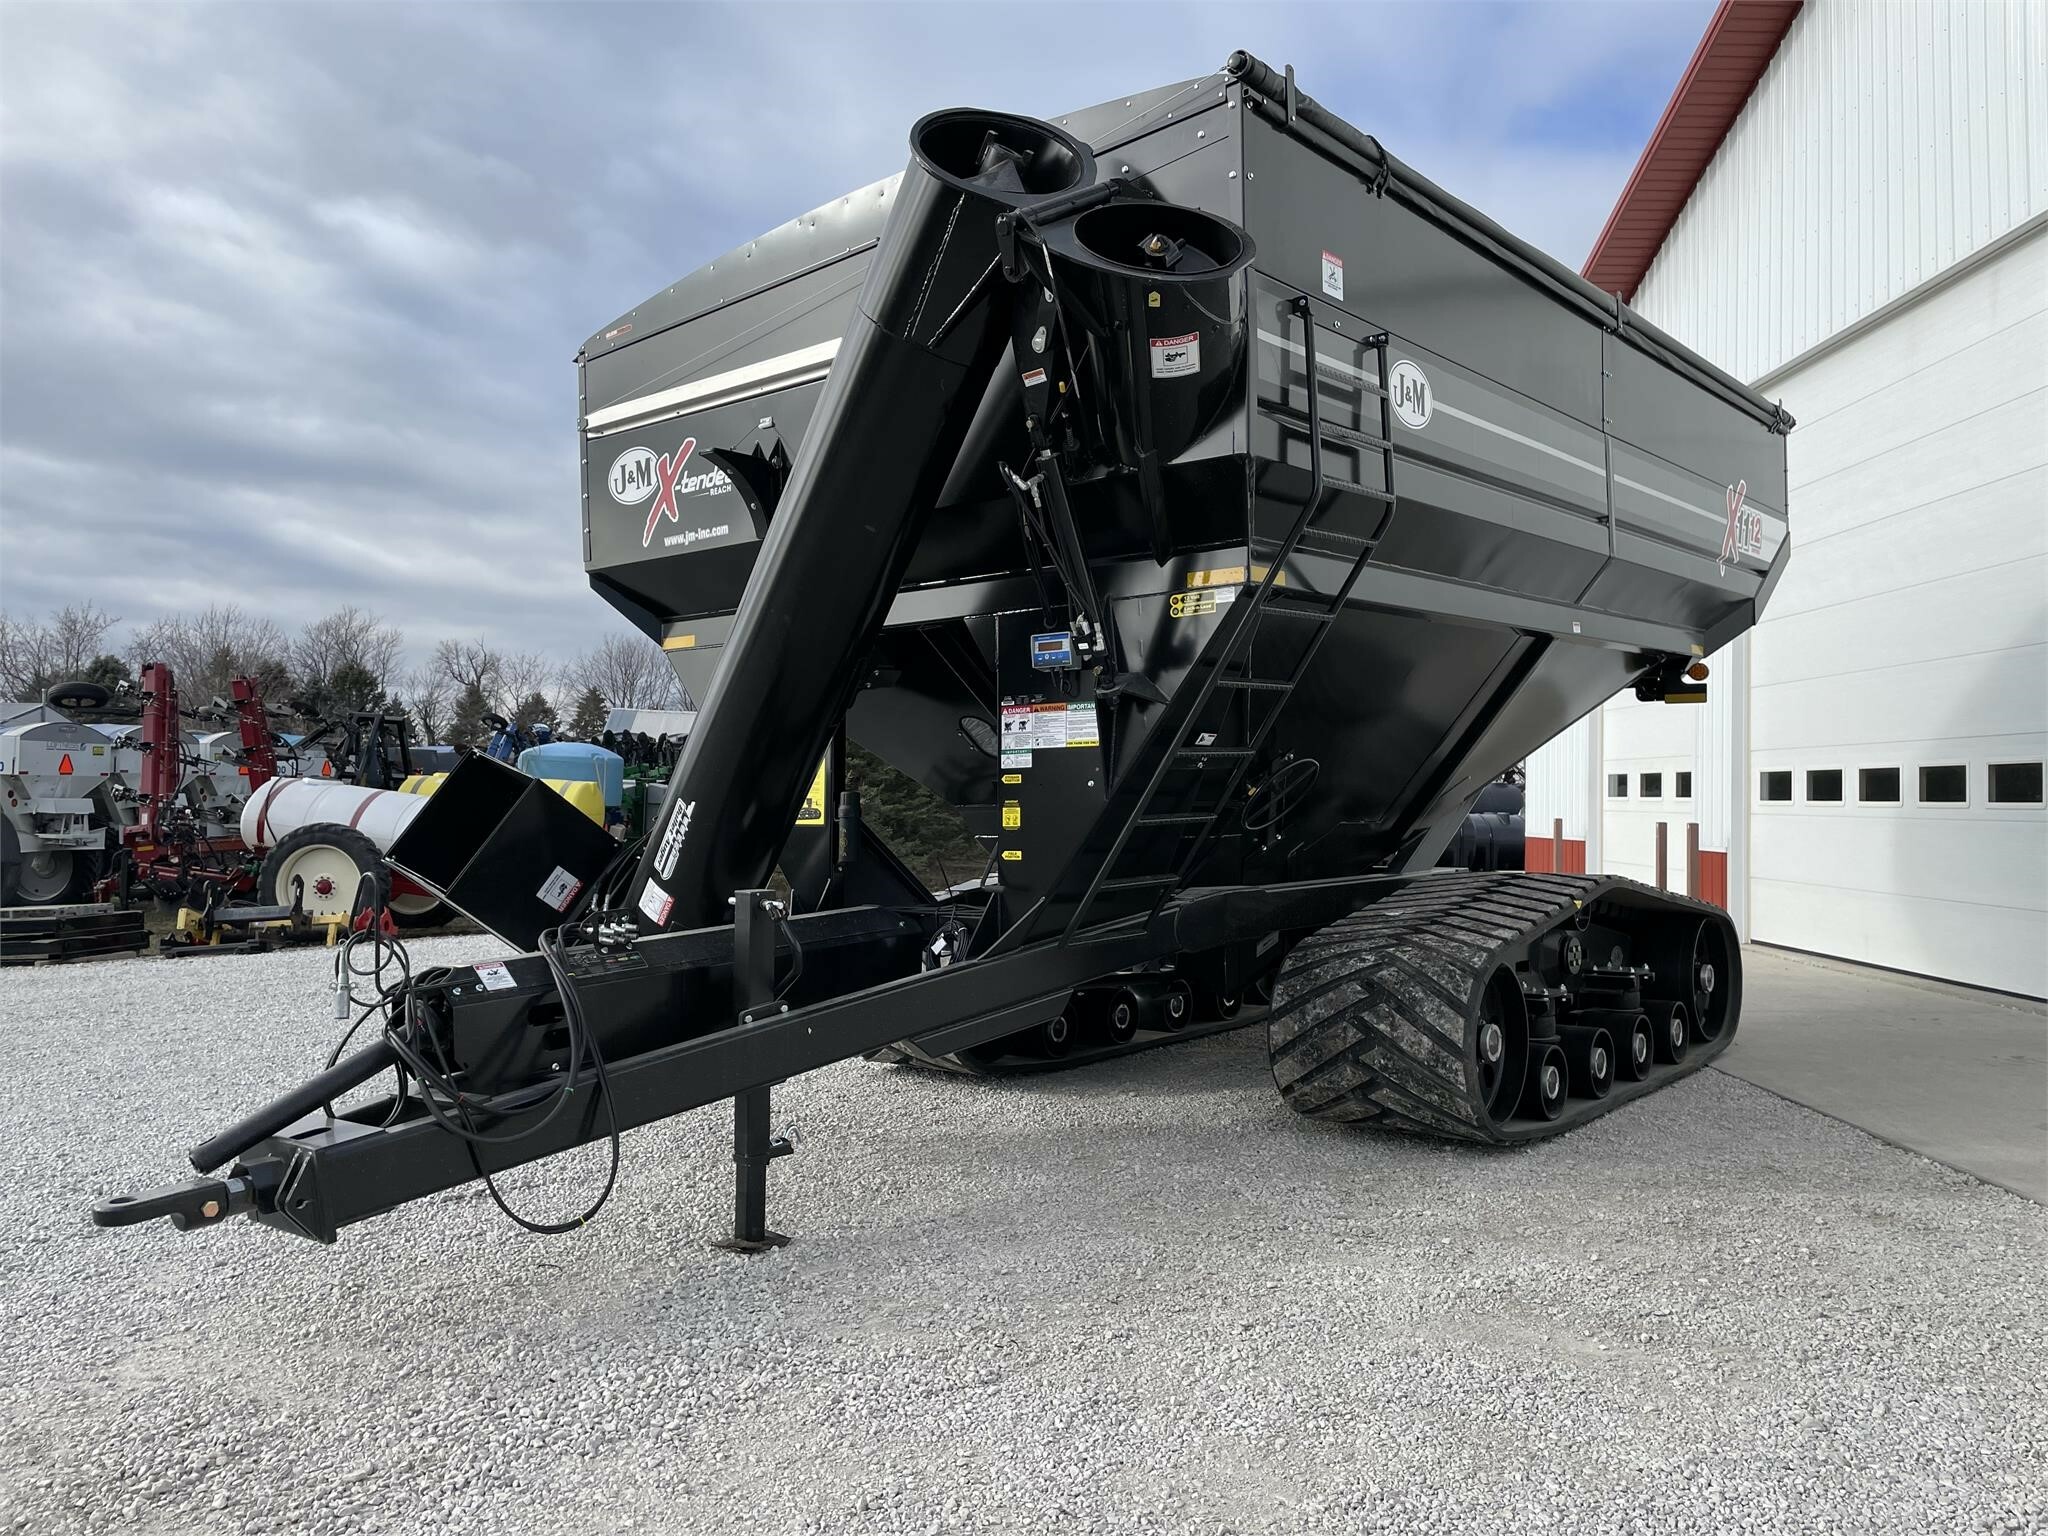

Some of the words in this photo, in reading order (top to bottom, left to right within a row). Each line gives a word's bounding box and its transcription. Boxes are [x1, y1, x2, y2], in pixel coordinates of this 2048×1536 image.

[1163, 335, 1194, 346] DANGER
[1393, 373, 1426, 417] J&M
[613, 457, 653, 495] J&M
[710, 484, 732, 496] REACH
[664, 524, 729, 547] www.jm-inc.com
[1008, 707, 1031, 715] DANGER
[1040, 704, 1065, 712] WARNING
[559, 885, 579, 911] DANGER
[659, 900, 673, 924] DANGER
